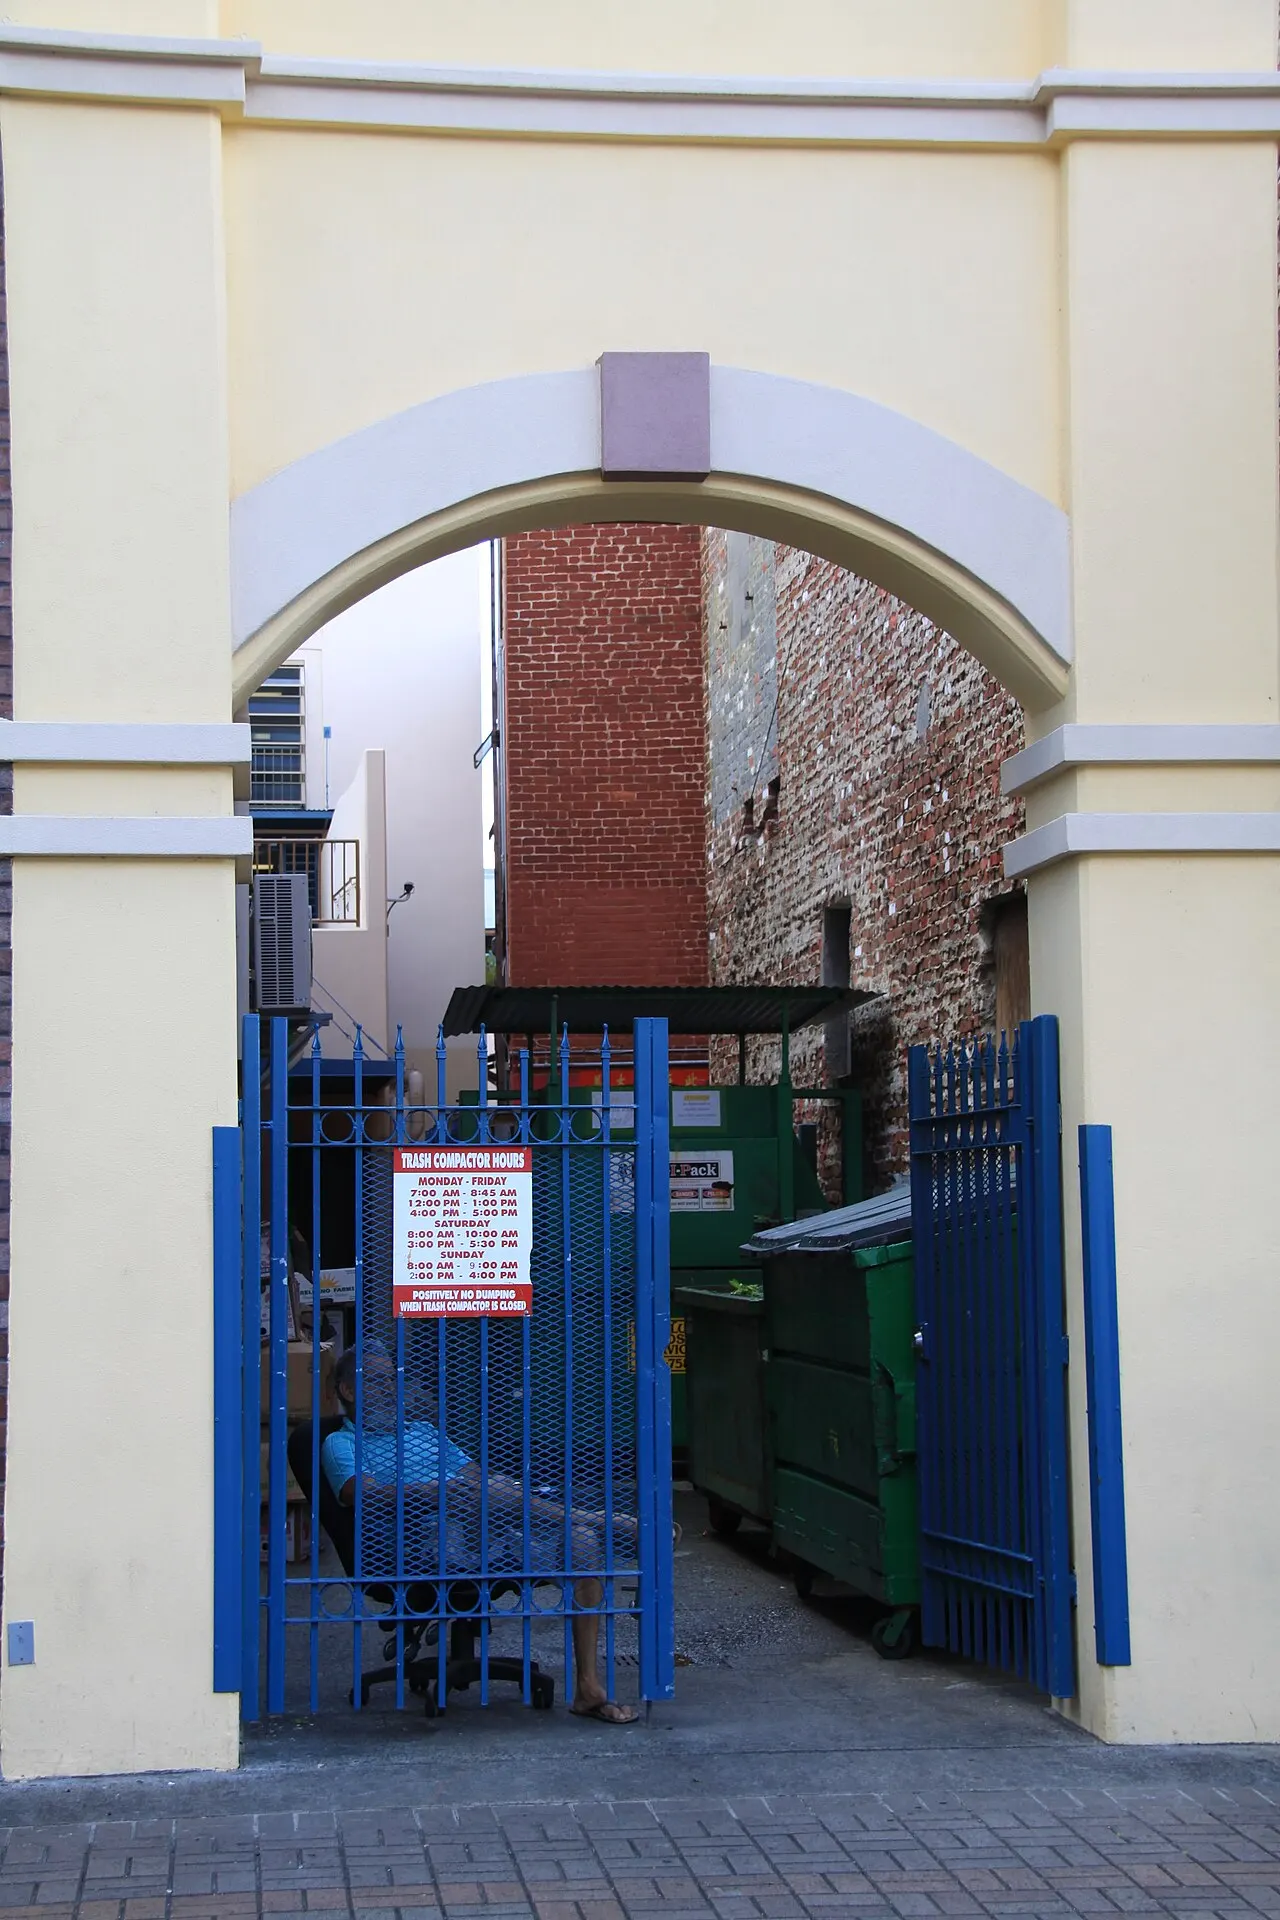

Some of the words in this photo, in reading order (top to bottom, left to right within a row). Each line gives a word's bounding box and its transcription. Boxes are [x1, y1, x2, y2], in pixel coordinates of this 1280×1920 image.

[401, 1153, 431, 1168] TRASH
[434, 1153, 490, 1168] COMPACTOR
[492, 1153, 524, 1168] HOURS
[418, 1177, 463, 1185] MONDAY
[472, 1177, 507, 1185] FRIDAY
[443, 1209, 459, 1217] PM
[441, 1251, 484, 1259] SUNDAY
[407, 1262, 432, 1270] 8:00
[413, 1290, 460, 1300] POSITIVELY
[463, 1290, 474, 1299] NO
[476, 1290, 515, 1299] DUMPING
[400, 1302, 421, 1311] WHEN
[423, 1302, 446, 1311] TRASH
[447, 1301, 490, 1311] COMPACTOR
[492, 1301, 498, 1310] IS
[500, 1301, 526, 1310] CLOSED
